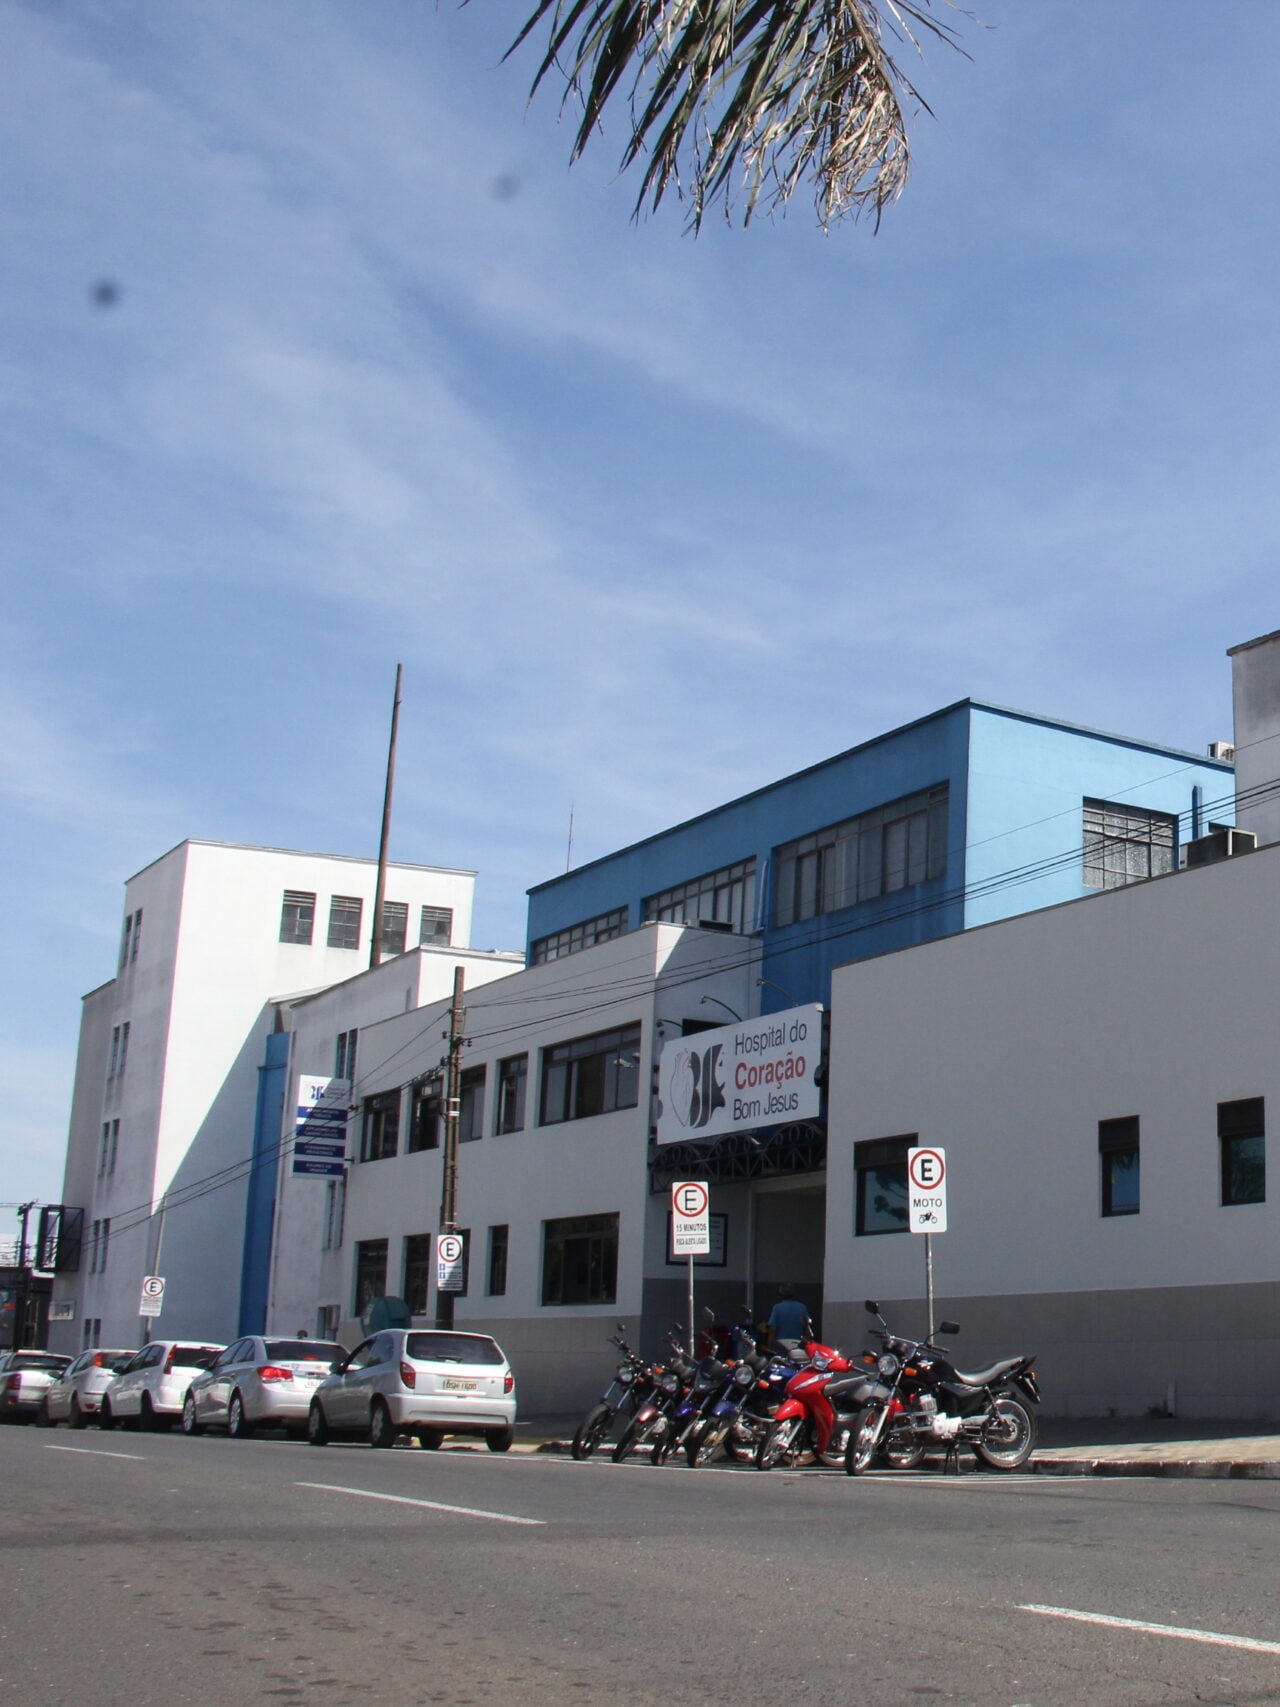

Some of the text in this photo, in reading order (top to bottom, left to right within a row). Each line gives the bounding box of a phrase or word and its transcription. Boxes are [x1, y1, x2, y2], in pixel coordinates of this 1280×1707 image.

[735, 1020, 807, 1056] Hospital do
[735, 1052, 806, 1089] Coração
[734, 1092, 798, 1120] Bom Jesus
[921, 1158, 933, 1181] E
[684, 1189, 697, 1211] E
[913, 1198, 942, 1208] MOTO
[683, 1223, 707, 1232] MINUTOS
[446, 1242, 455, 1257] E
[150, 1281, 158, 1292] E
